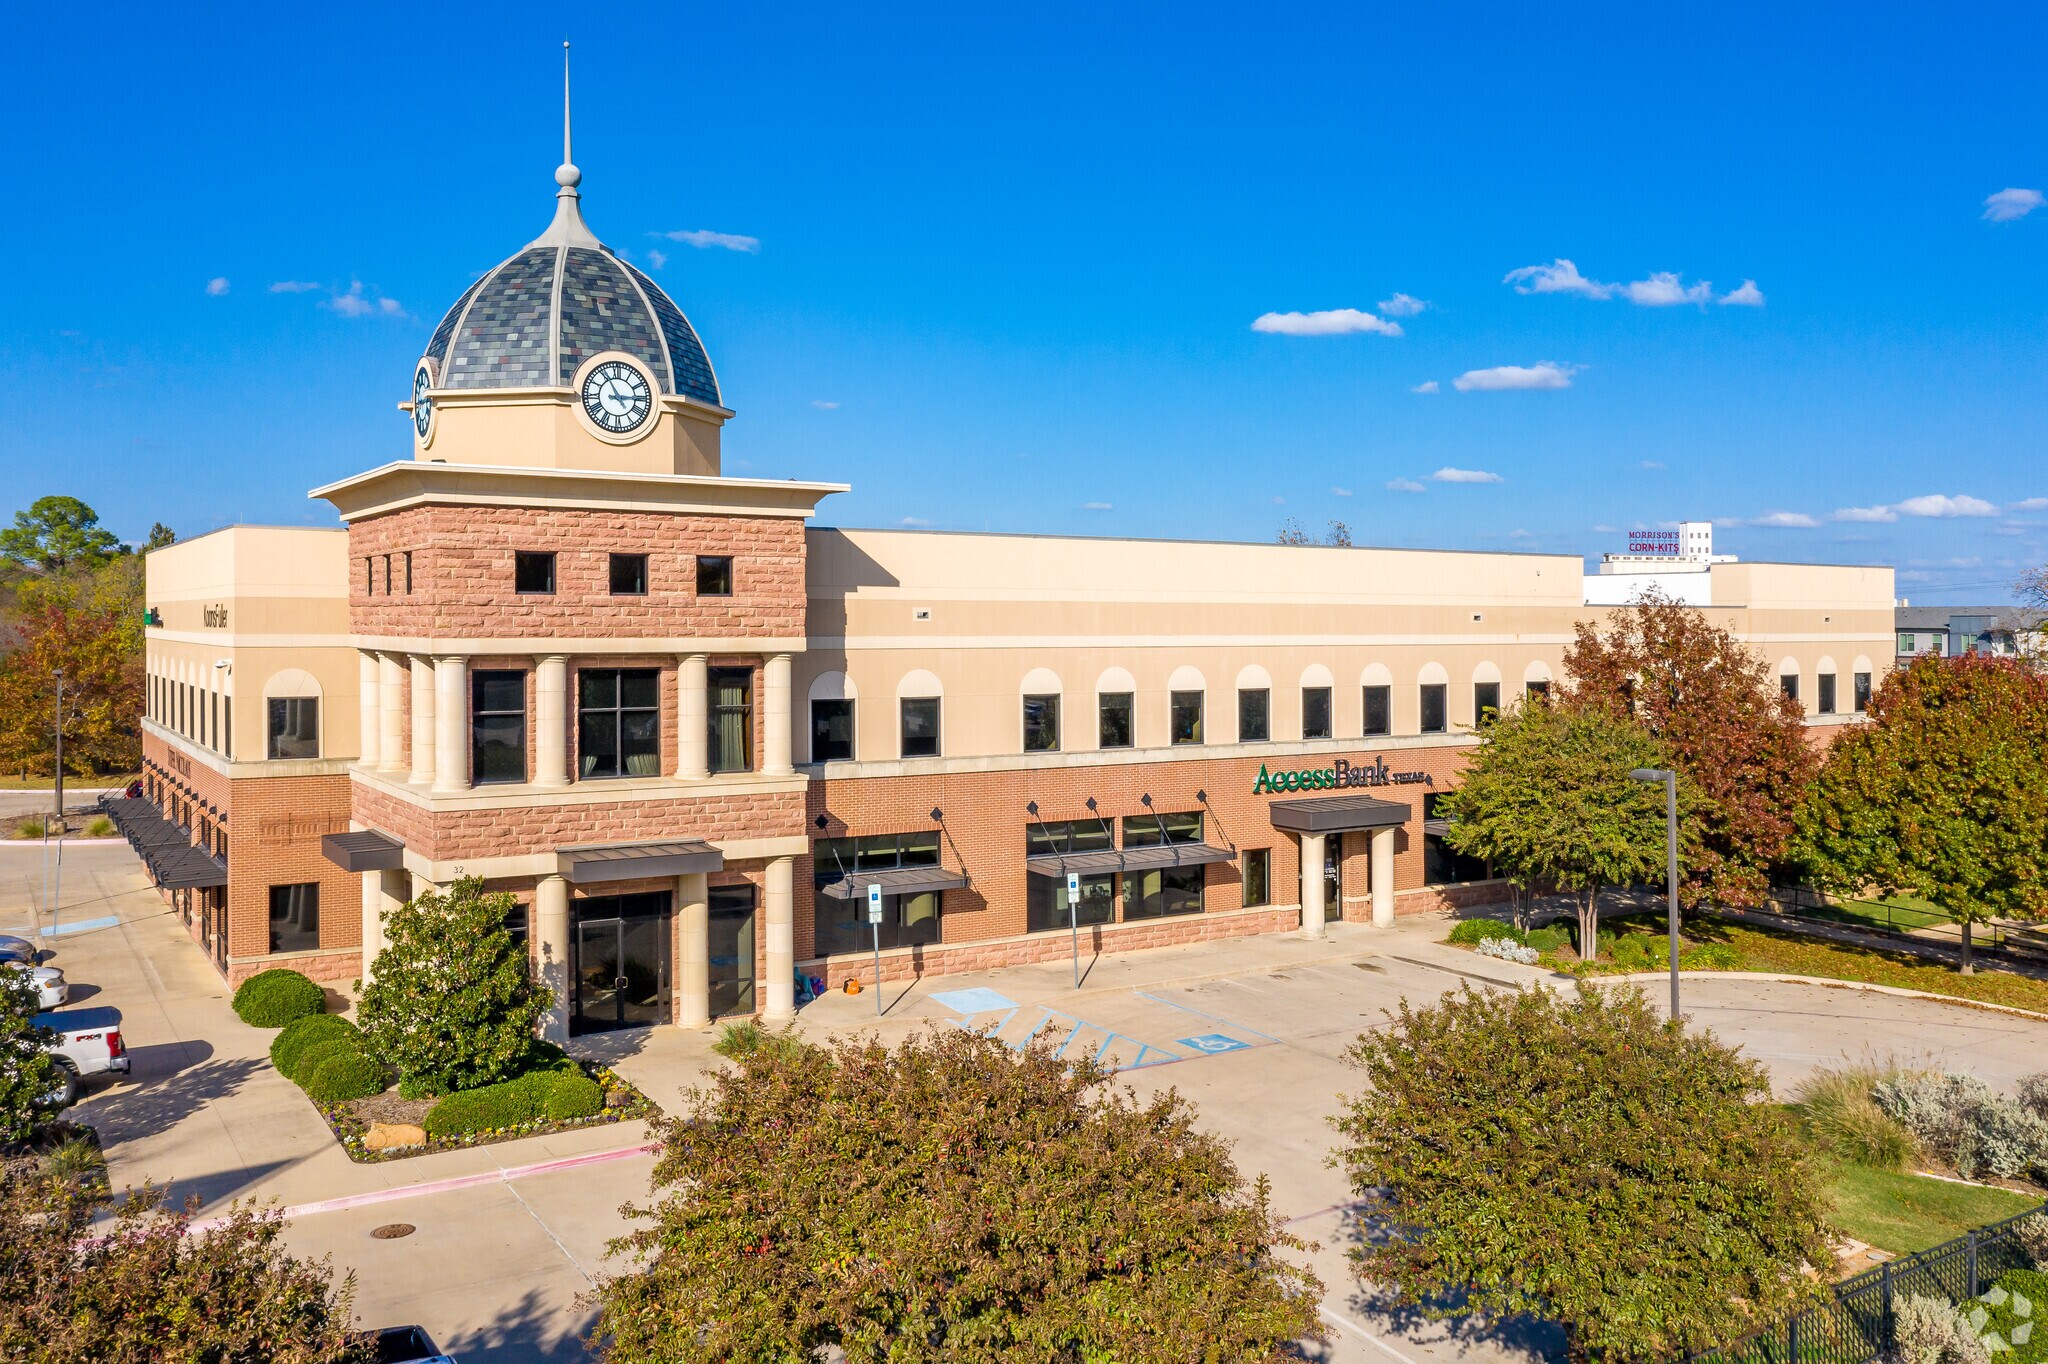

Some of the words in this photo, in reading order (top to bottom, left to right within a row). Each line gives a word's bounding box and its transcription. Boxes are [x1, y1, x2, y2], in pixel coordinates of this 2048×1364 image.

[1628, 531, 1680, 539] MORRISON'S
[1629, 543, 1680, 552] CORN-KITS
[1253, 755, 1390, 793] AccessBank
[1392, 771, 1426, 784] TEXAS
[76, 1033, 102, 1042] FX4
